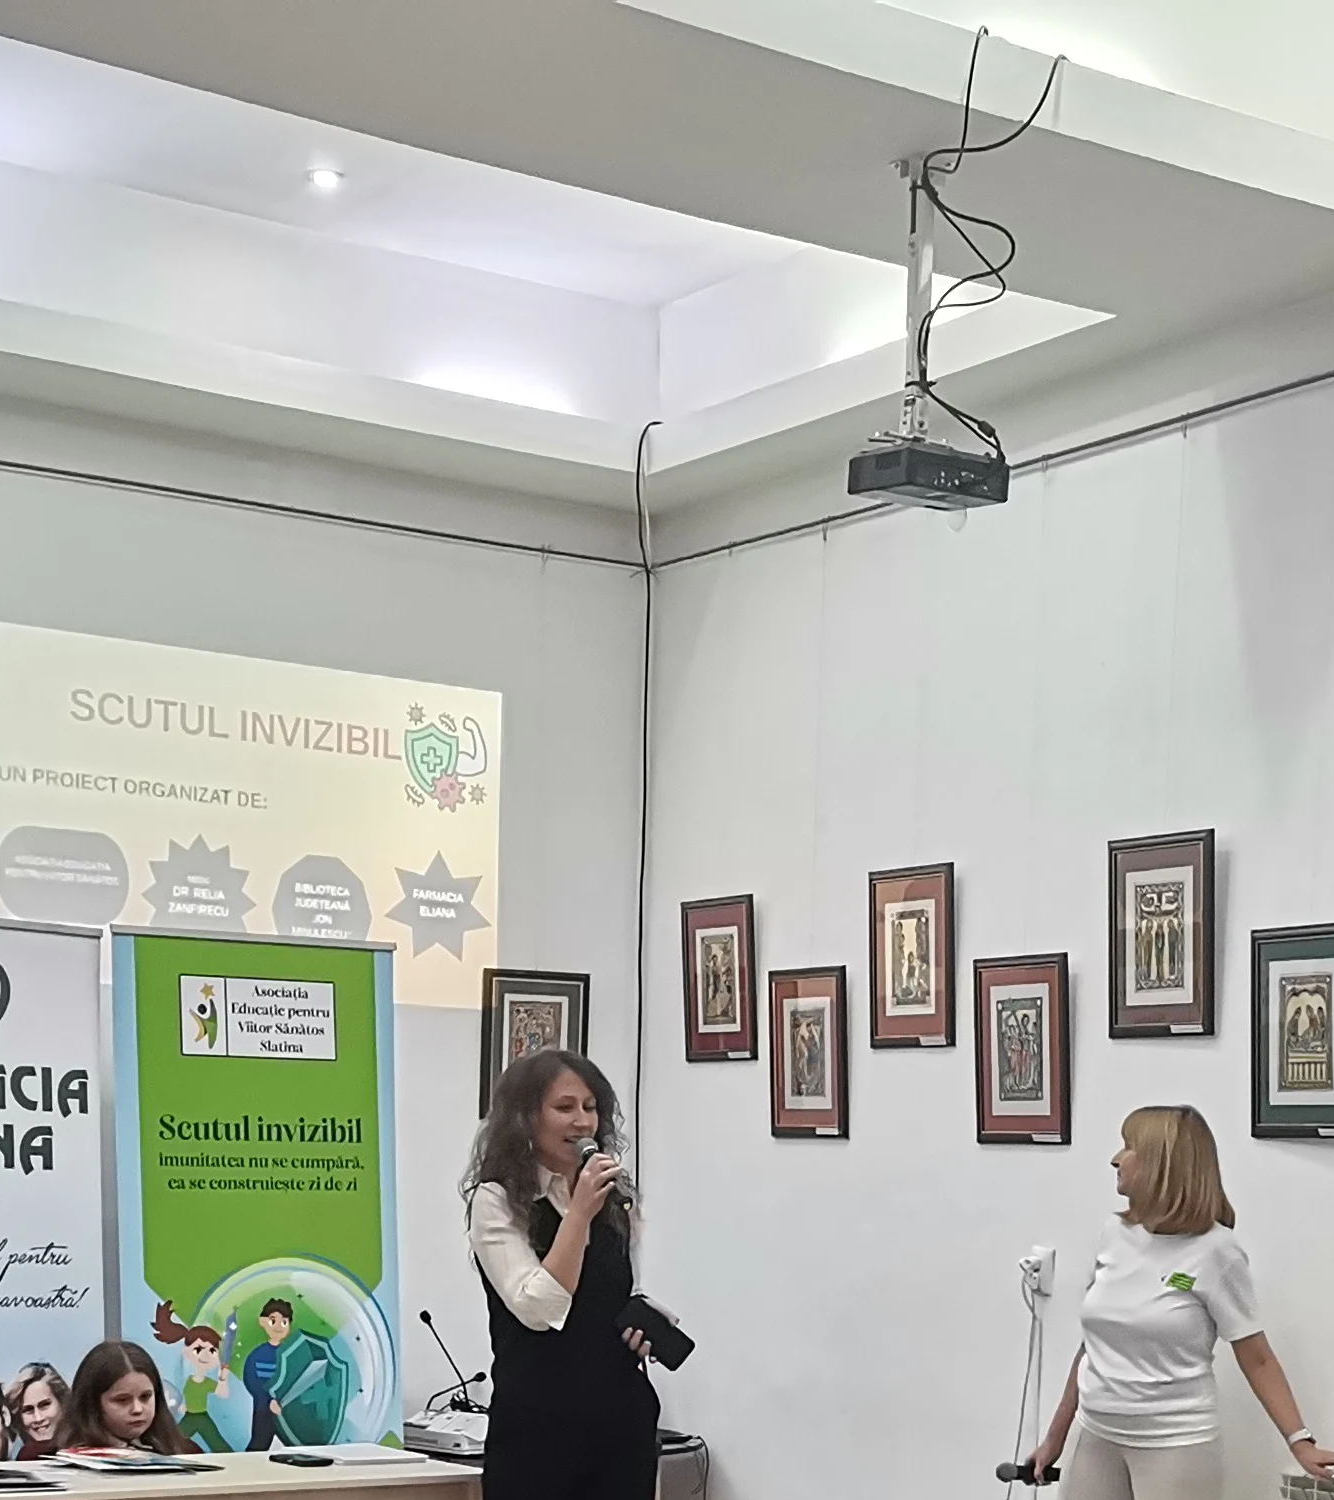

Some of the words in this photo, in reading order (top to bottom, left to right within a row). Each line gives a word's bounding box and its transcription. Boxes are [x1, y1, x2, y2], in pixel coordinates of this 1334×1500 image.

[69, 688, 229, 740] SCUTUL
[240, 709, 402, 761] INVIZIBIL
[32, 767, 118, 795] PROIECT
[123, 778, 232, 807] ORGANIZAT
[237, 790, 269, 810] DE:
[294, 882, 351, 897] BIBLIOTECA
[413, 888, 465, 904] FARMACIA
[419, 905, 457, 919] ELIANA
[252, 985, 309, 1001] Asociația
[231, 1002, 285, 1018] Educație
[287, 1006, 330, 1020] pentru
[238, 1020, 273, 1034] Viitor
[259, 1040, 304, 1054] Slatina
[158, 1113, 250, 1142] Scutul
[257, 1115, 362, 1143] invizibil
[248, 1156, 268, 1169] nu
[271, 1156, 288, 1169] se
[168, 1178, 186, 1191] ea
[189, 1178, 206, 1191] se
[209, 1177, 305, 1193] construiește
[308, 1176, 321, 1191] zi
[324, 1176, 343, 1191] de
[345, 1177, 358, 1191] zi
